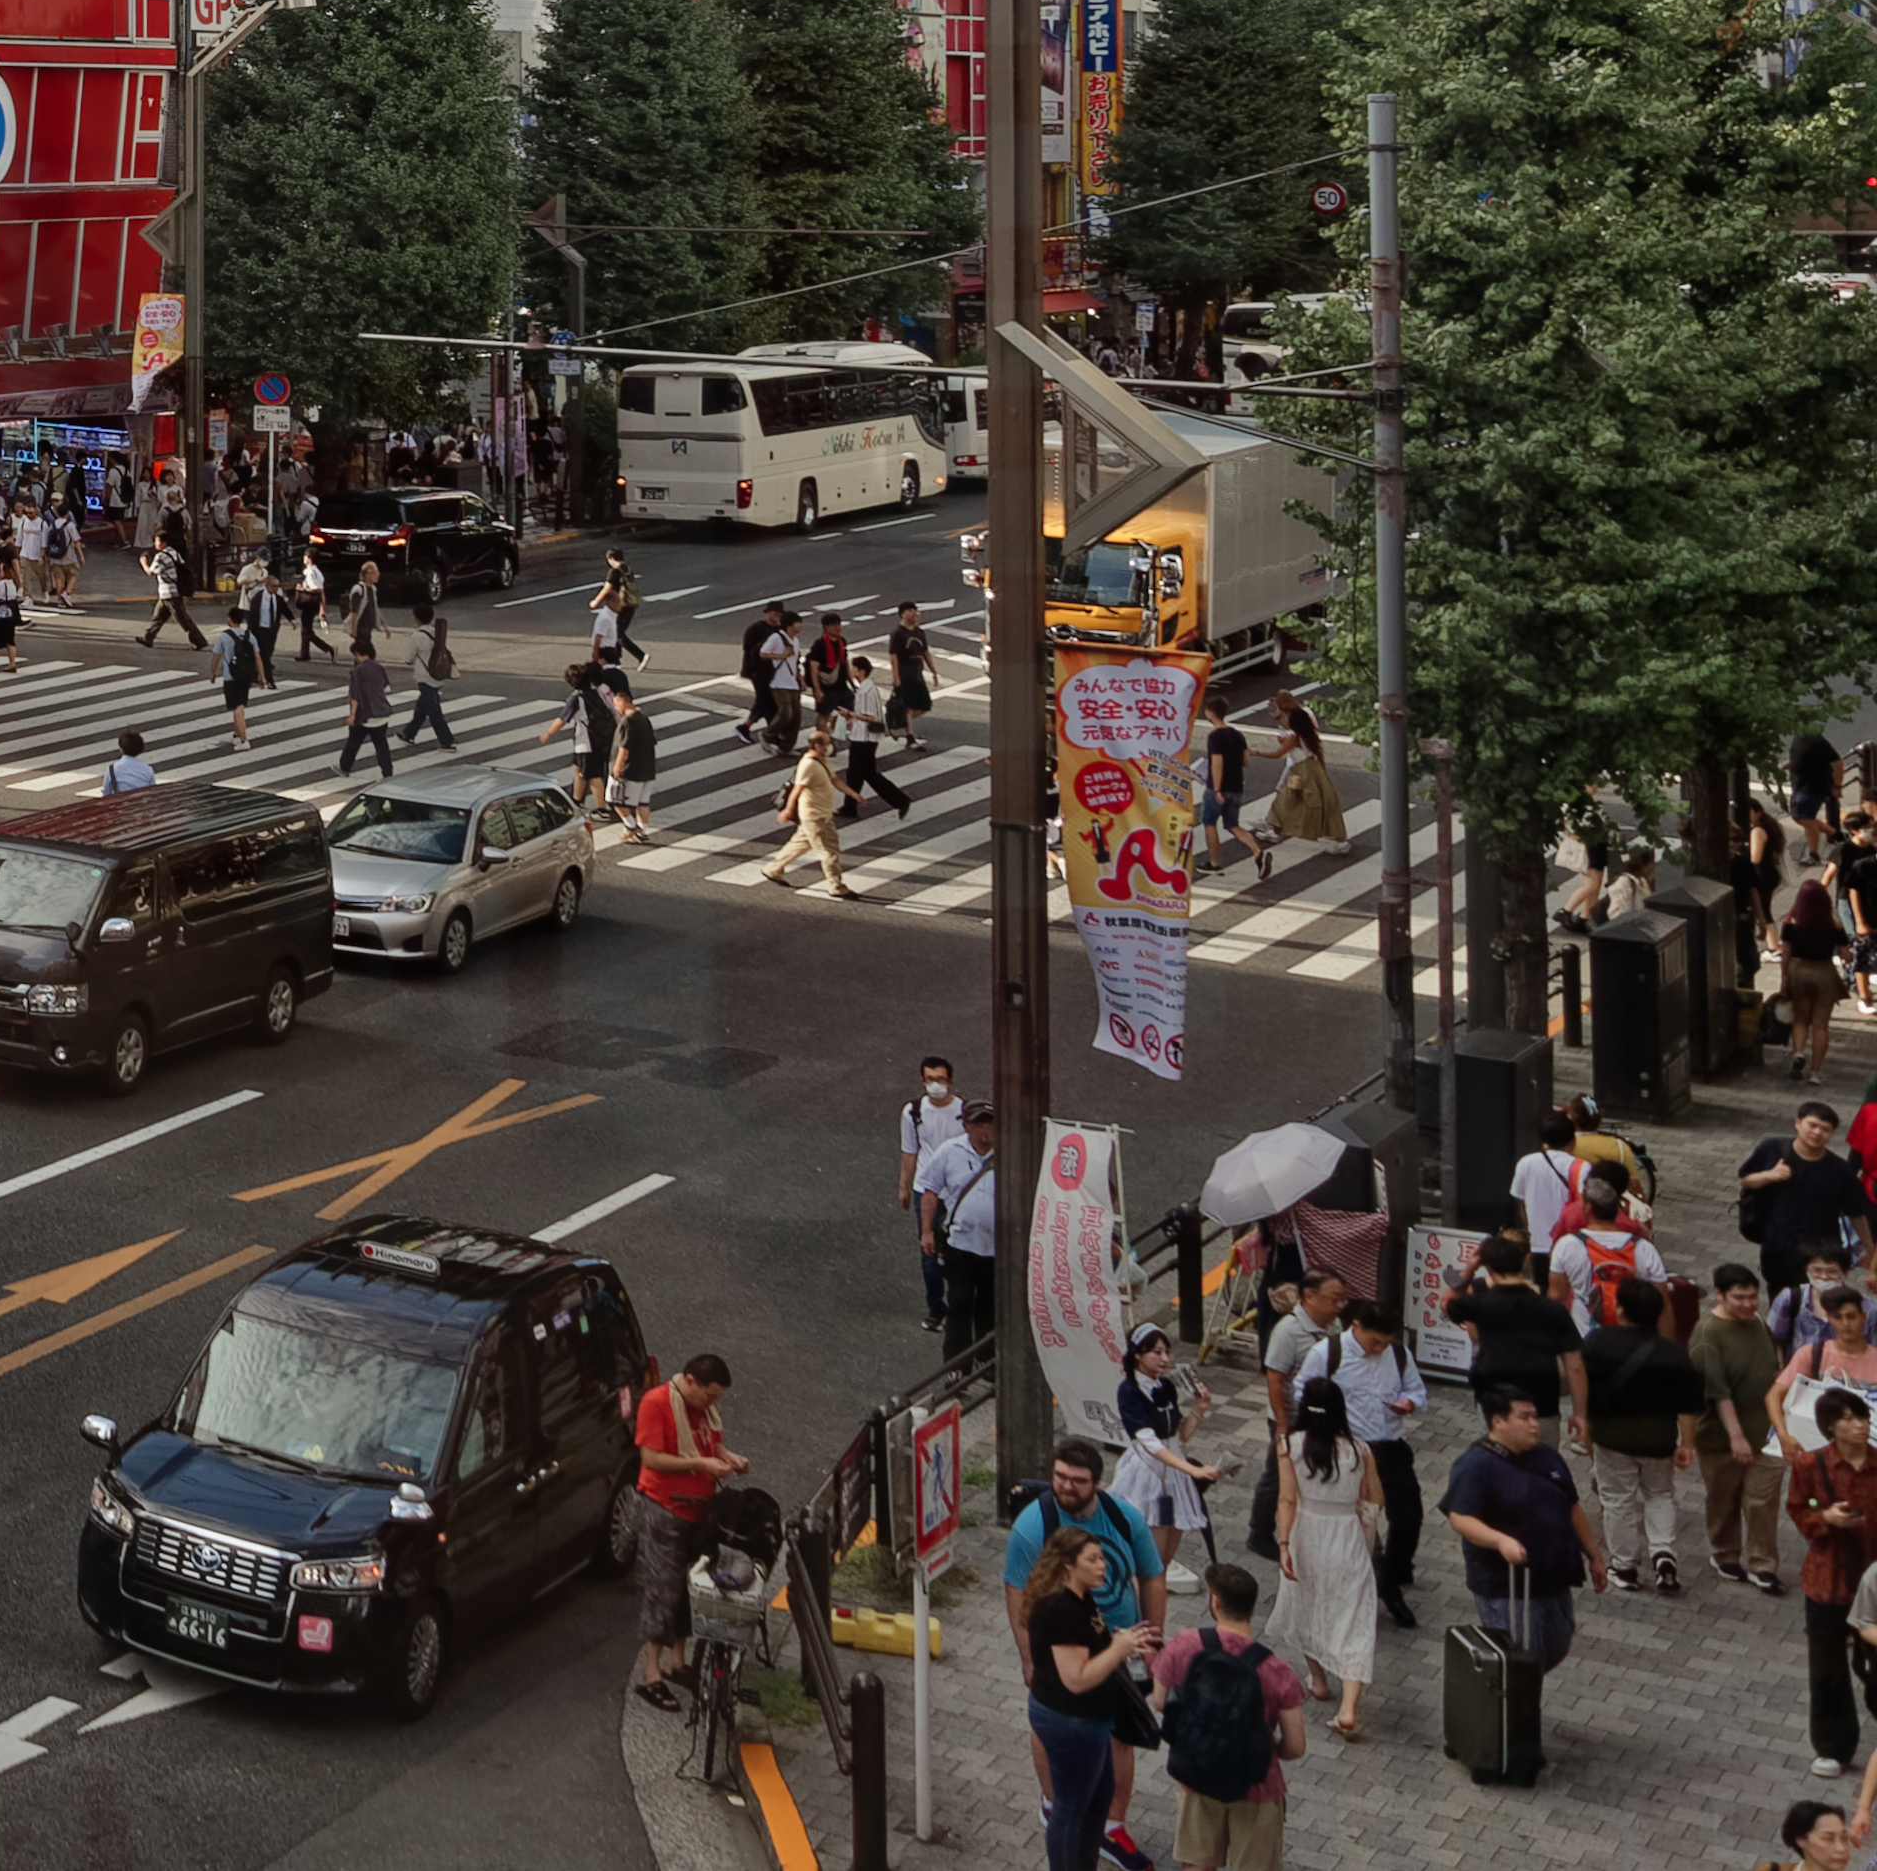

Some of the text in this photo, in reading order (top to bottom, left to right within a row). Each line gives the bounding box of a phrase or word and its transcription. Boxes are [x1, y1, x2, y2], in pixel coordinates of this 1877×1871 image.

[1318, 191, 1338, 206] 50
[1074, 677, 1176, 697] みんなで協力
[1077, 698, 1178, 722] 安全・安心
[1081, 723, 1181, 743] 元気なアキバ
[1423, 1233, 1442, 1329] もみほぐし
